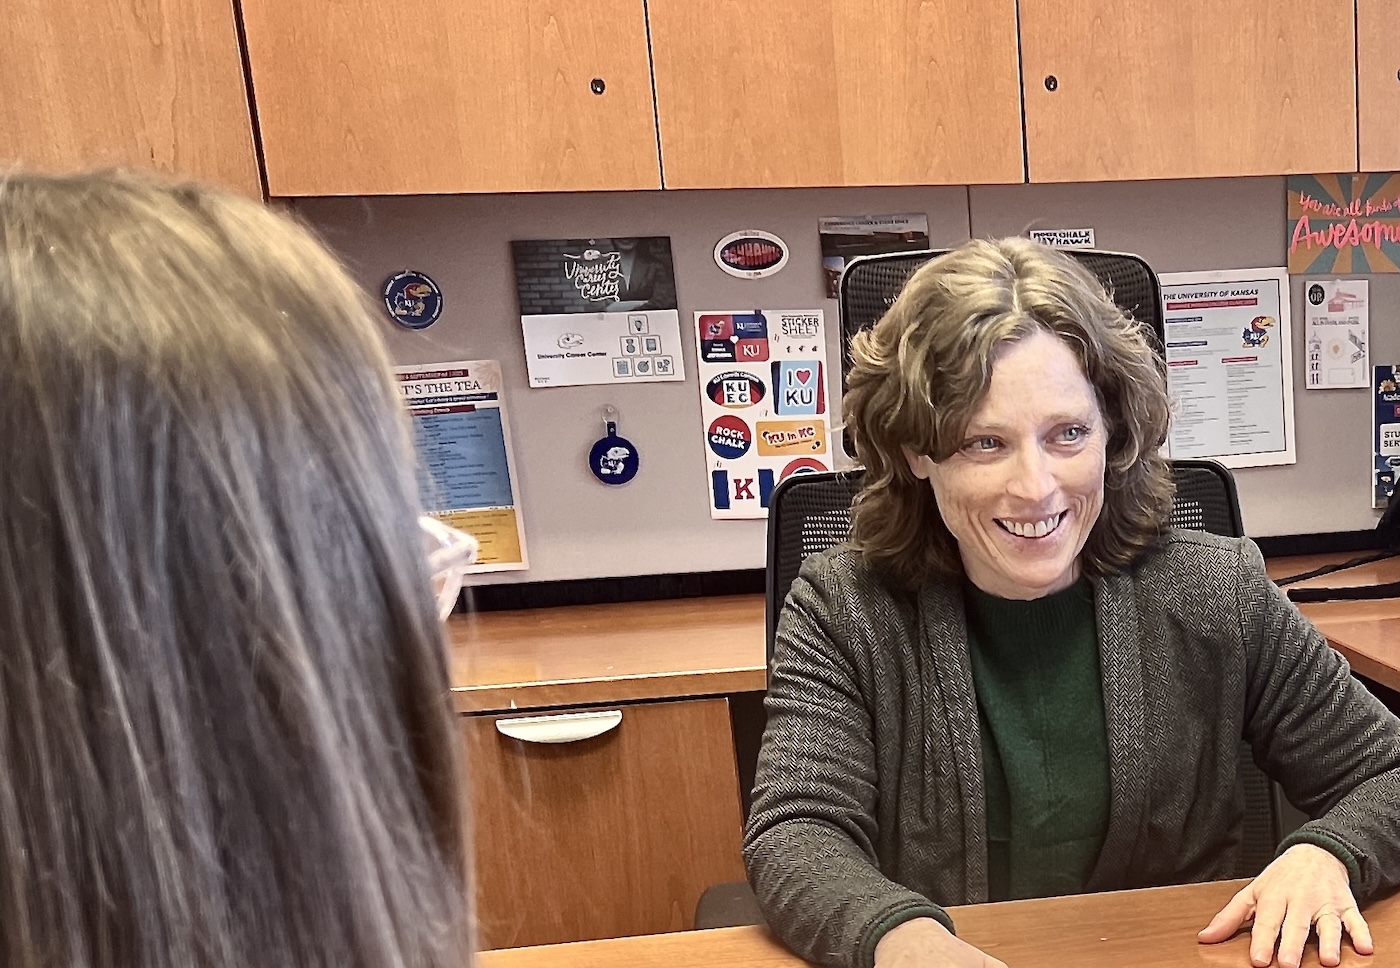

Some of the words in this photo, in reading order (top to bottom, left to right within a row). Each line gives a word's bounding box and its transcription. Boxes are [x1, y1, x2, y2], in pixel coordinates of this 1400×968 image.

[1300, 190, 1322, 213] You
[1323, 203, 1340, 217] are
[1343, 198, 1363, 217] all
[1366, 197, 1392, 217] kinds
[581, 280, 620, 302] Center
[1178, 291, 1217, 300] UNIVERSITY
[1230, 289, 1259, 297] KANSAS
[781, 317, 819, 327] STICKER
[782, 326, 818, 335] SHEET
[743, 344, 760, 357] KU
[788, 371, 792, 386] I
[401, 384, 422, 395] T'S
[425, 382, 452, 393] THE
[455, 380, 482, 390] TEA
[786, 388, 813, 406] KU
[715, 426, 745, 440] ROCK
[711, 434, 746, 450] CHALK
[733, 478, 755, 500] K
